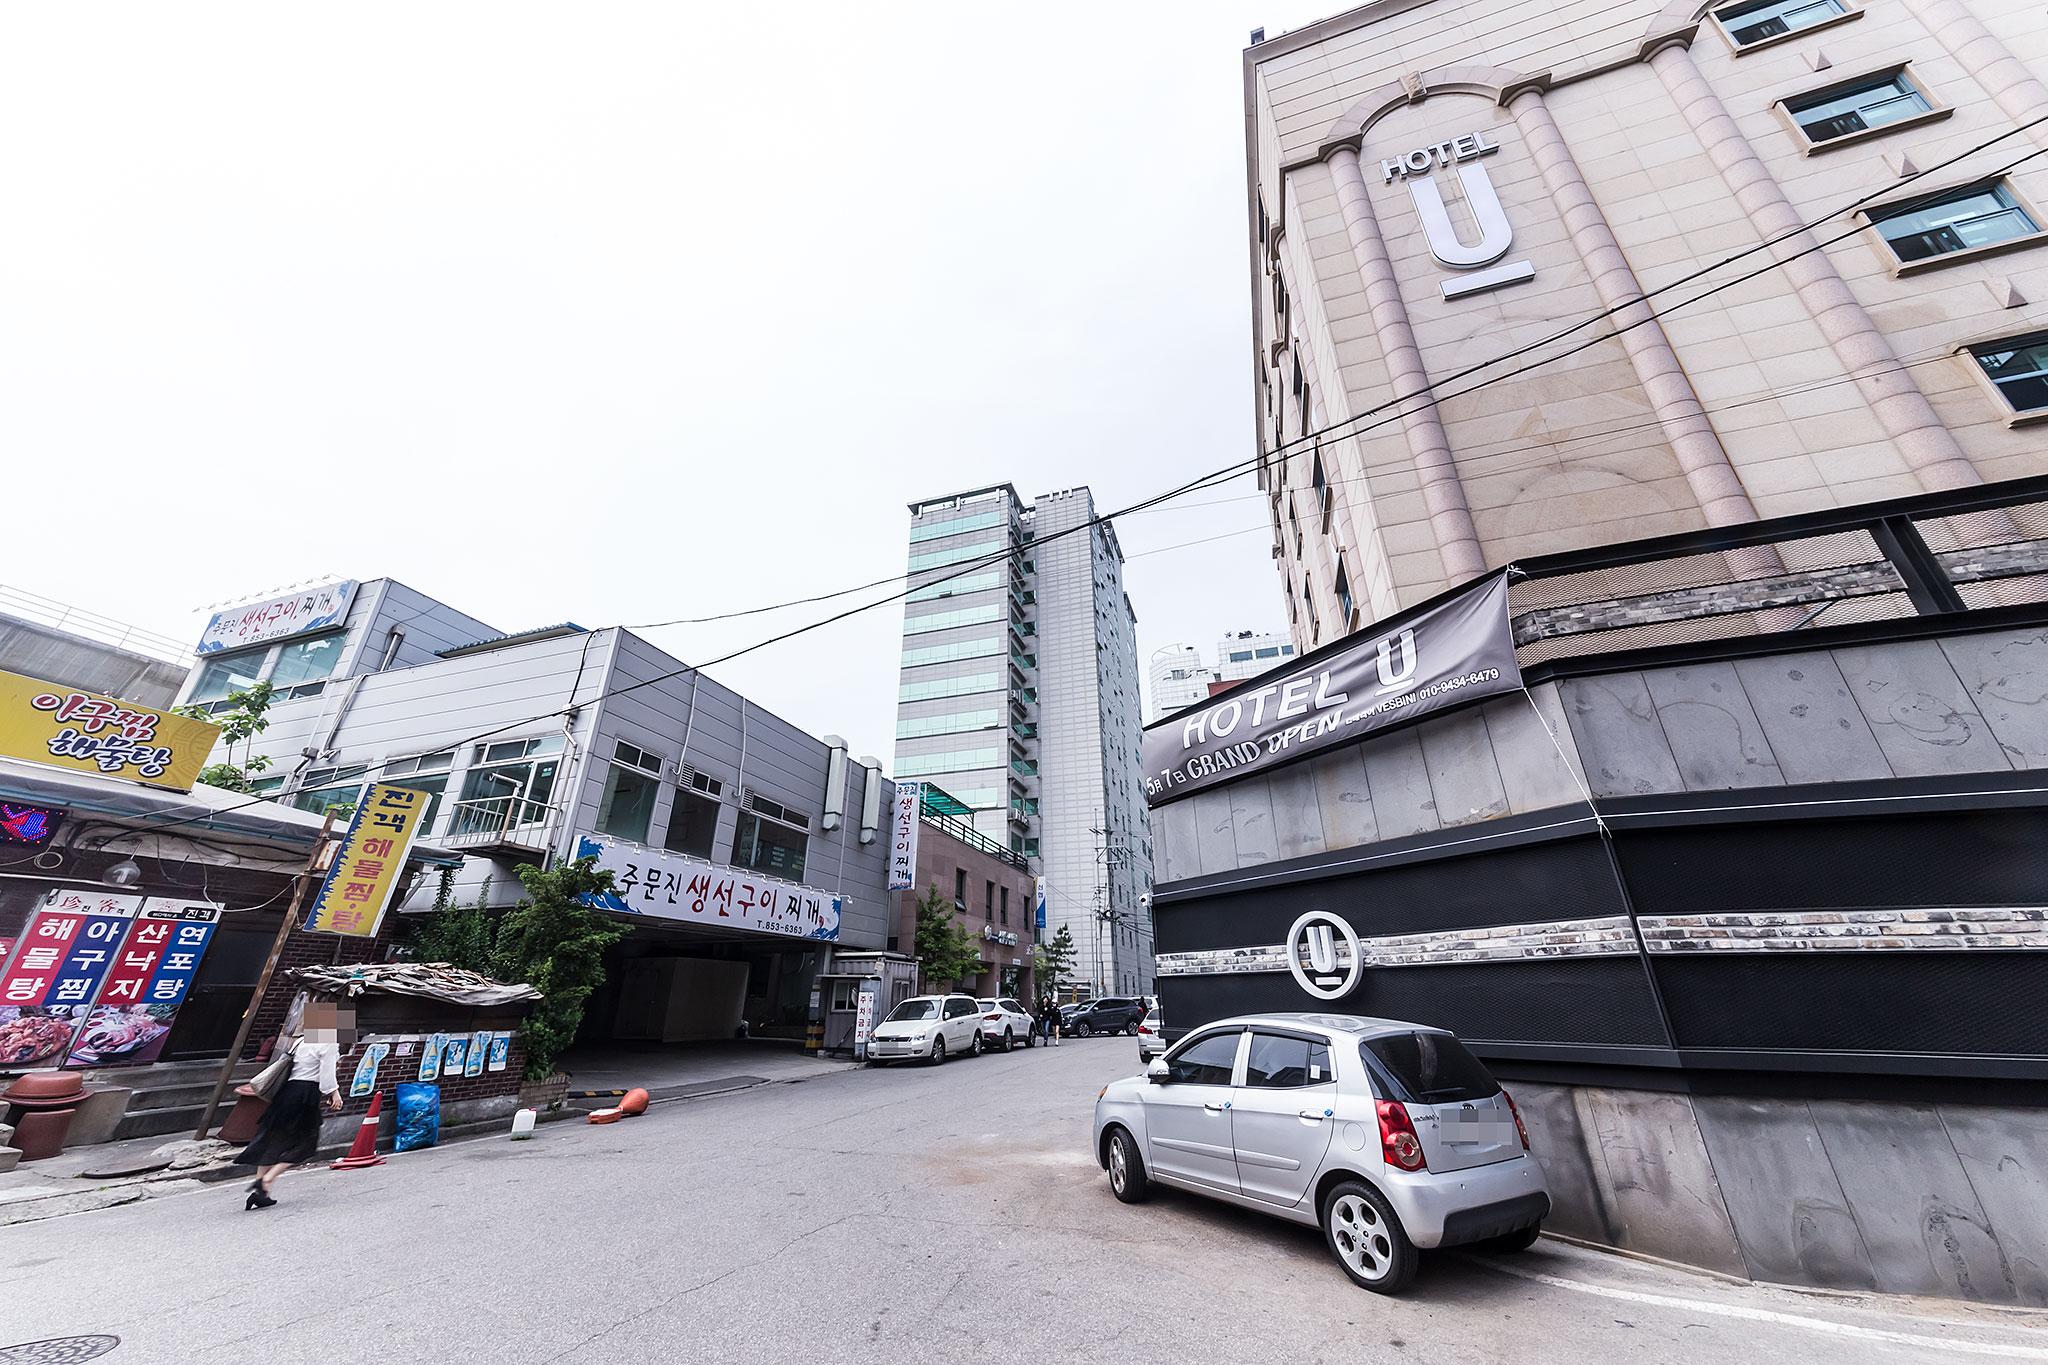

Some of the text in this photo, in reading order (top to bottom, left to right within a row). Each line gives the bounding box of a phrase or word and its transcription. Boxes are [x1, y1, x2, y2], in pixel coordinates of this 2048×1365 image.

[1381, 130, 1500, 184] HOTEL
[1408, 161, 1513, 269] U
[212, 619, 238, 636] 주문진
[33, 694, 160, 740] 아구찜
[1183, 628, 1418, 749] HOTEL U
[48, 728, 172, 777] 해물탕
[1187, 741, 1261, 779] GRAND
[1267, 710, 1343, 754] OPEN
[373, 790, 415, 833] 진객
[185, 909, 212, 920] 진객
[620, 863, 683, 904] 주문진
[786, 894, 820, 925] 찌개
[757, 920, 803, 934] T.853-6363
[6, 918, 77, 1000] 해물탕
[56, 922, 120, 1000] 아구찜
[108, 924, 169, 999] 산낙지
[153, 926, 208, 999] 연포탕
[857, 995, 867, 1039] 주차금지
